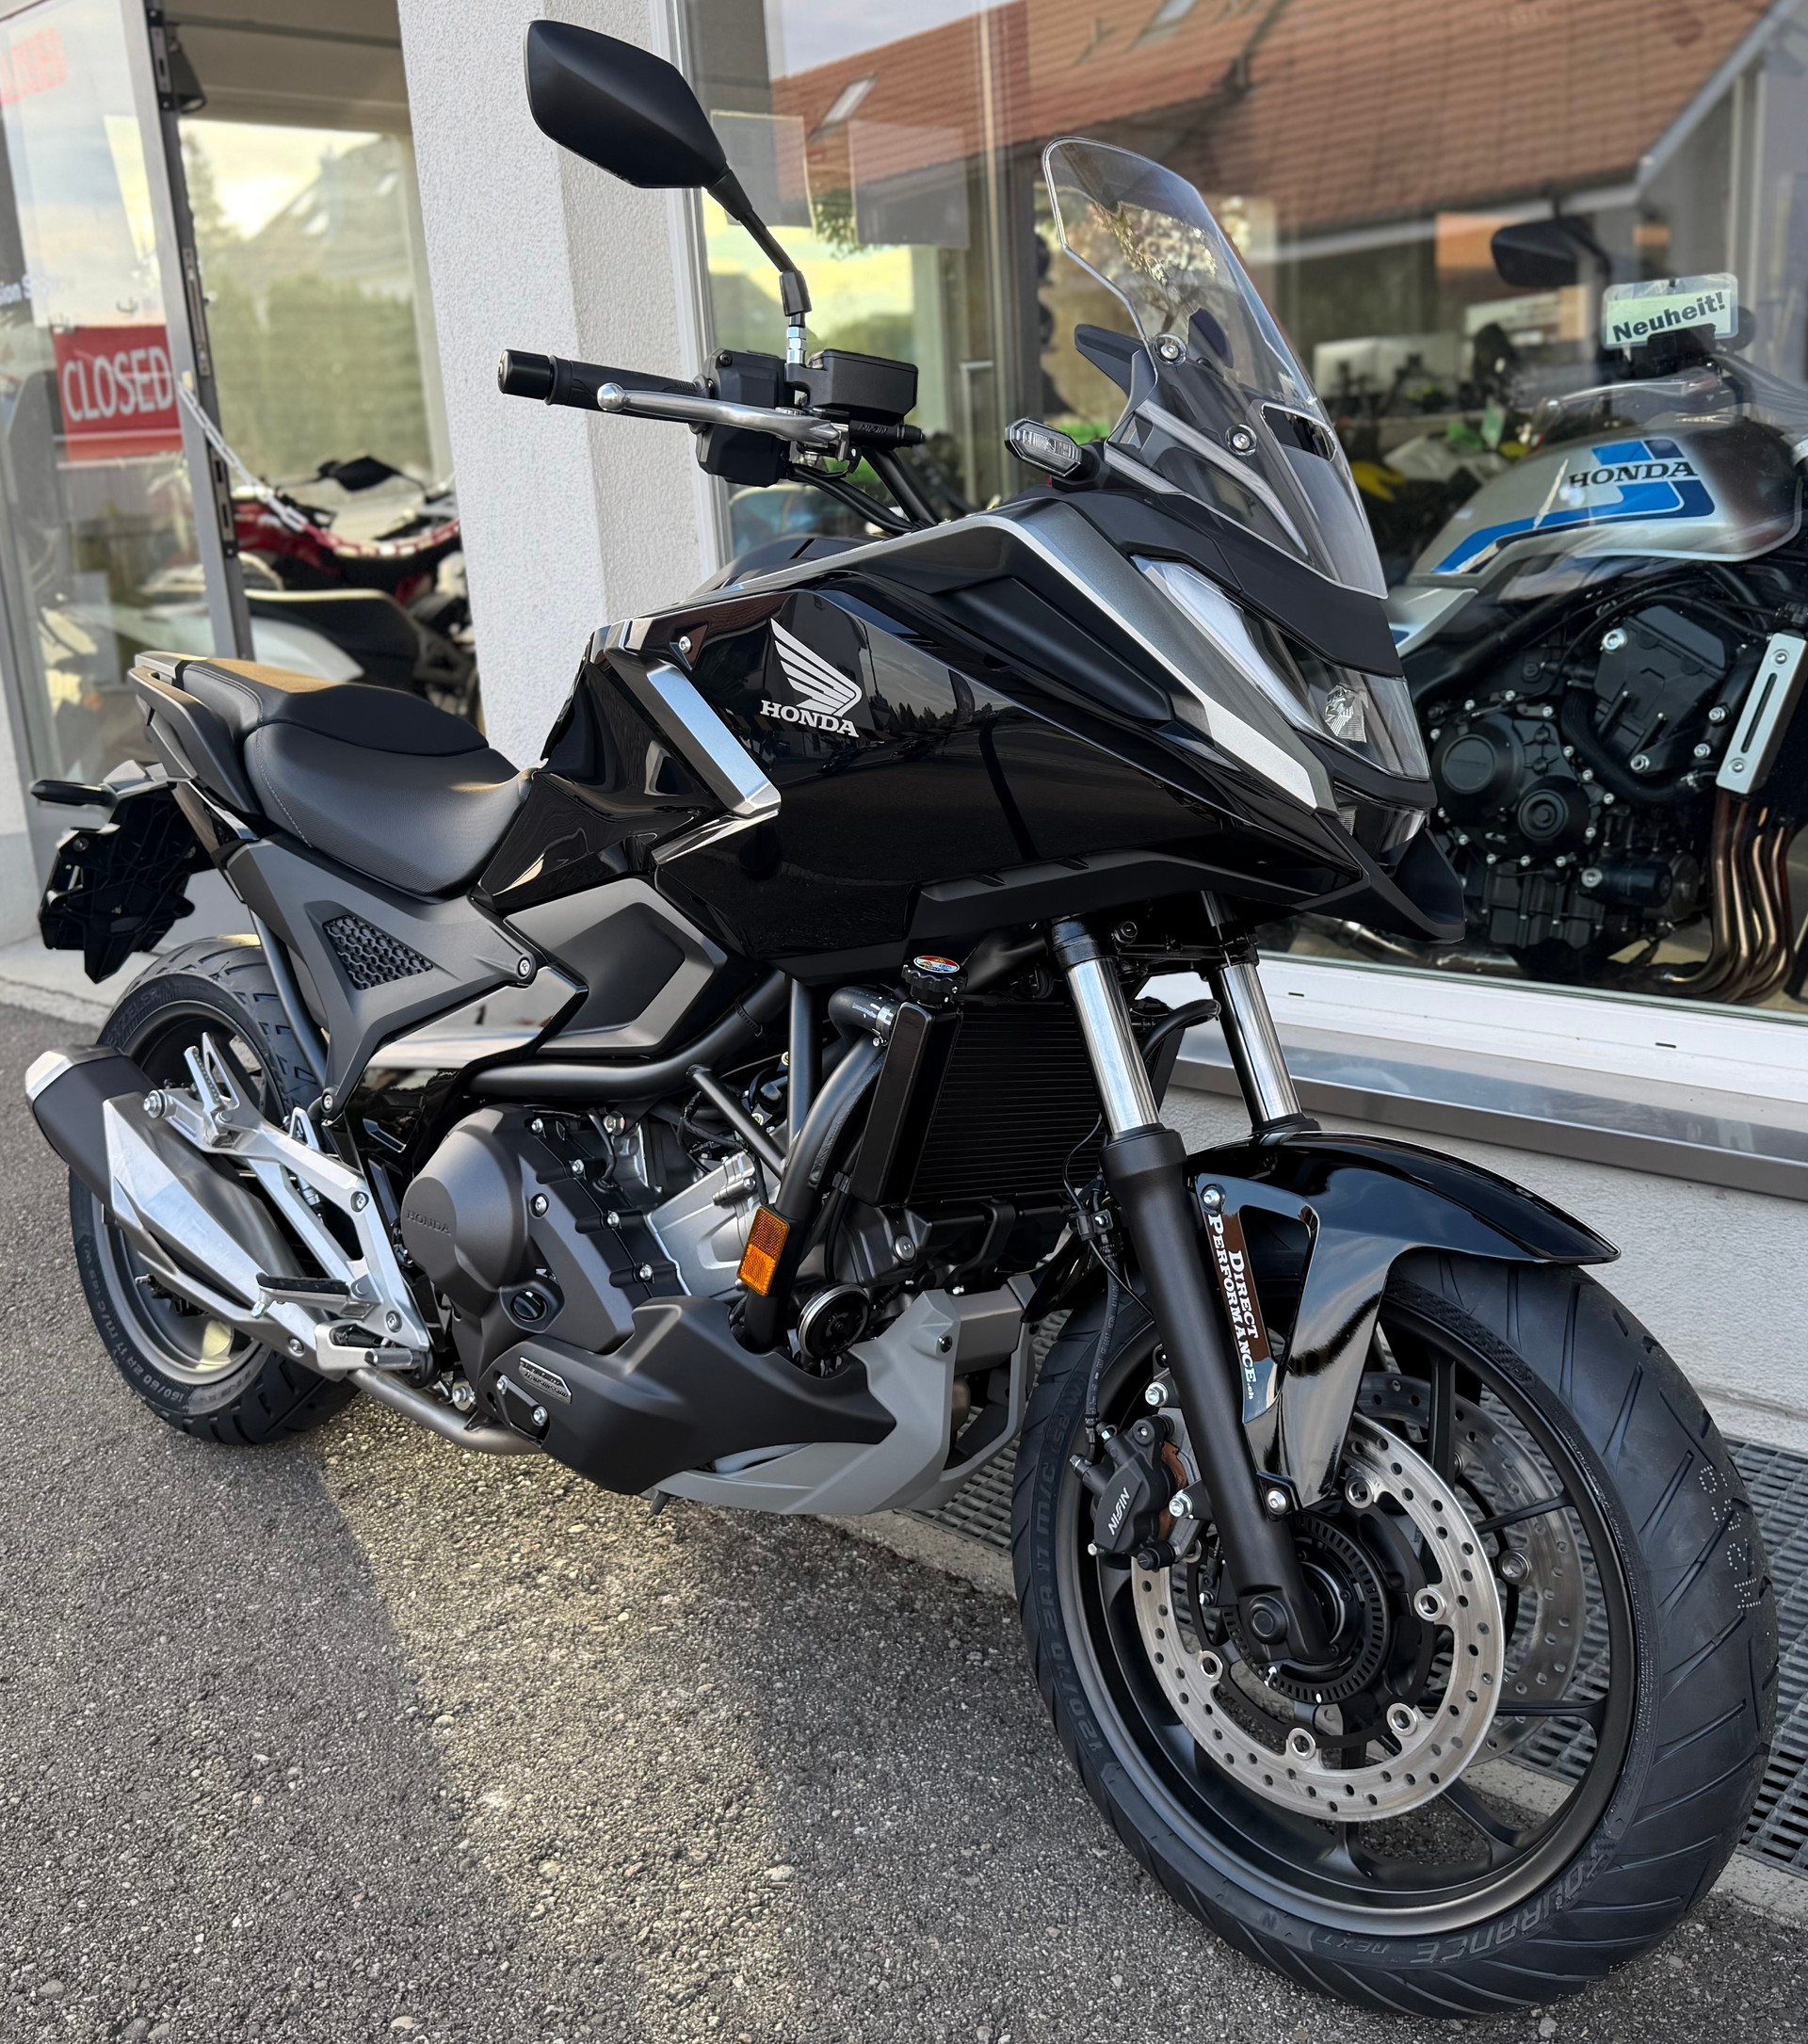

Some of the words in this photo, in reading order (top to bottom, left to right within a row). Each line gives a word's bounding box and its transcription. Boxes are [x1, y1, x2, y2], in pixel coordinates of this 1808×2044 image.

[1612, 292, 1725, 342] Neuheit!
[62, 346, 173, 422] CLOSED
[1569, 461, 1699, 488] HONDA
[760, 700, 859, 737] HONDA
[407, 1210, 451, 1235] HONDA
[1207, 1214, 1256, 1400] PERFORMANCE.ch
[1228, 1249, 1259, 1339] DIRECT
[1036, 1462, 1057, 1535] M/C
[1107, 1487, 1130, 1536] NISSIN
[1050, 1641, 1105, 1752] 120/70
[1410, 1843, 1605, 1964] TOURANCE
[1316, 1935, 1391, 1955] NEXT
